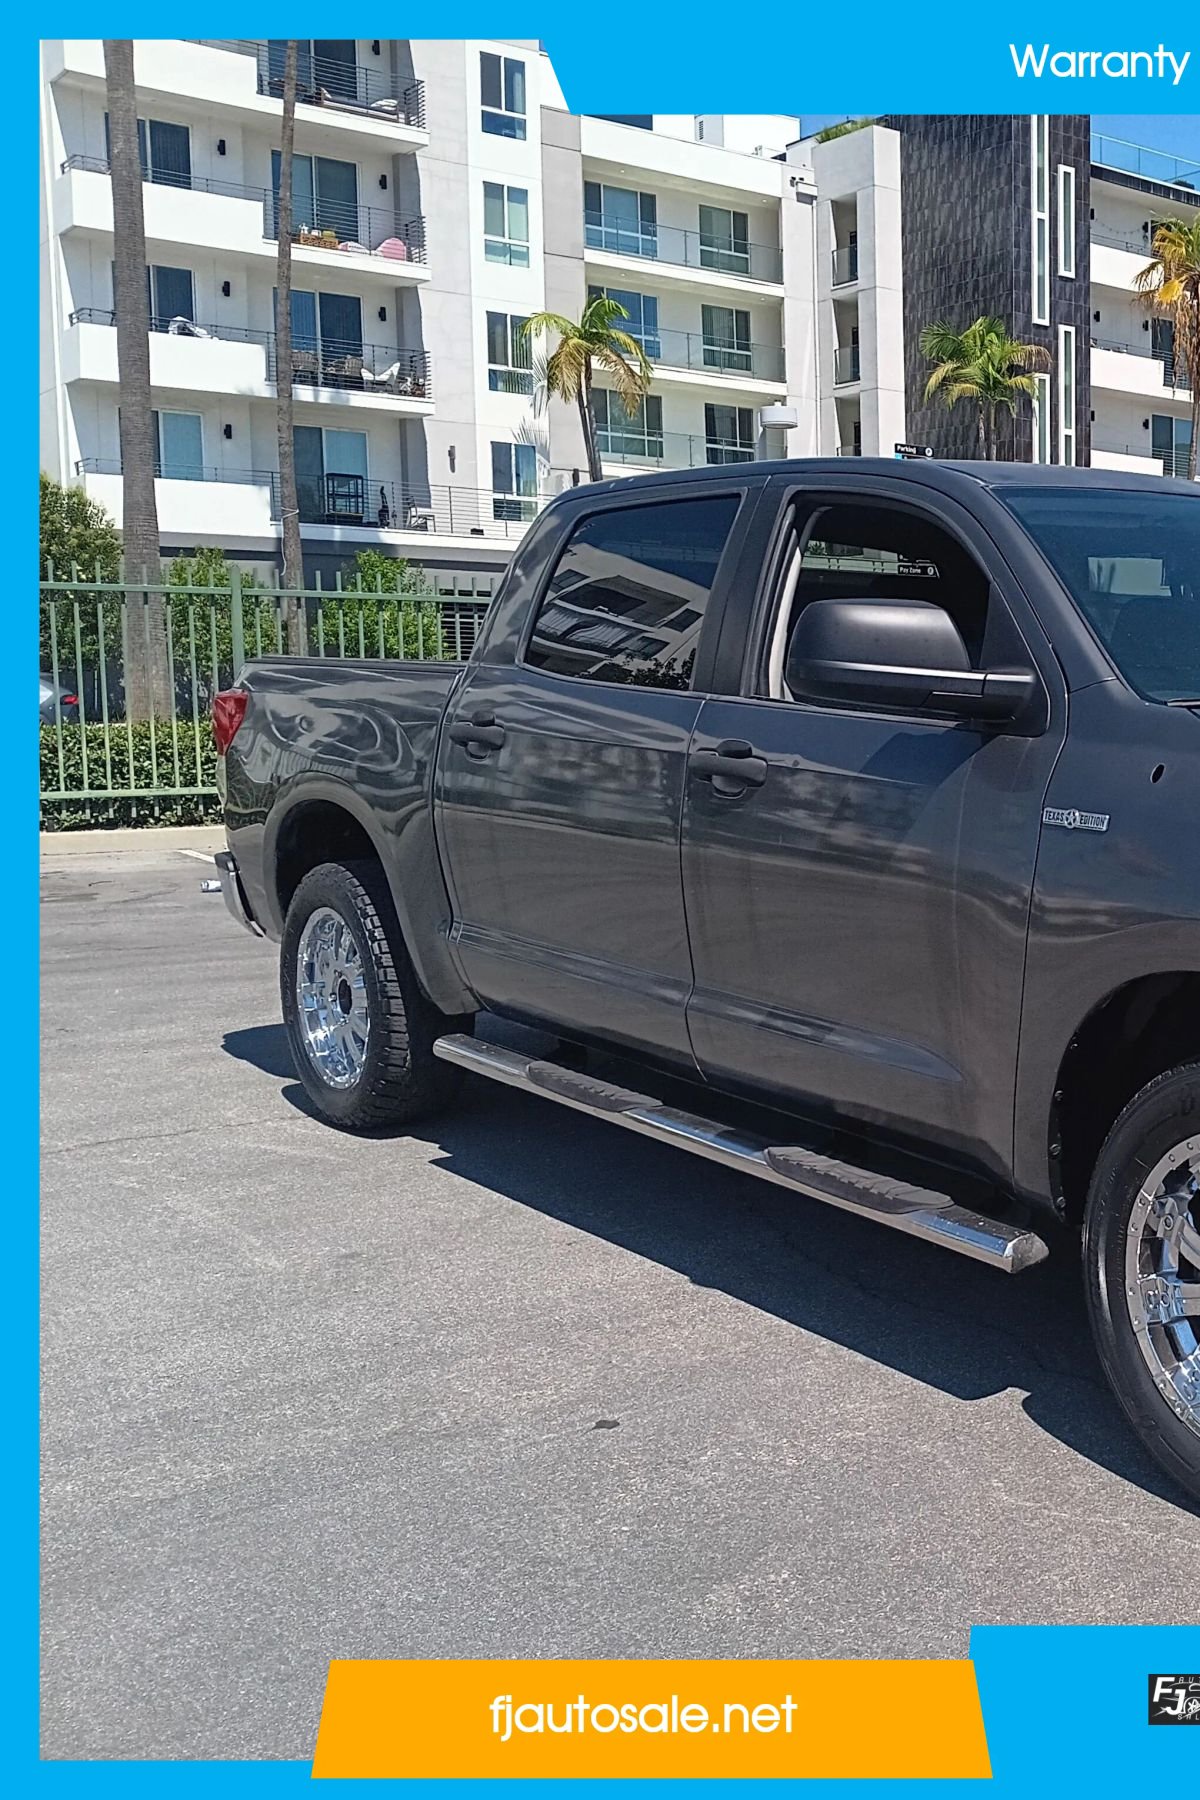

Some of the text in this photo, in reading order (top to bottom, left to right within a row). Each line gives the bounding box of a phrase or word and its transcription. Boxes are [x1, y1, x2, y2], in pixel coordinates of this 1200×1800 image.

[897, 445, 916, 454] Parking
[1044, 810, 1105, 827] TEXAS EDITION
